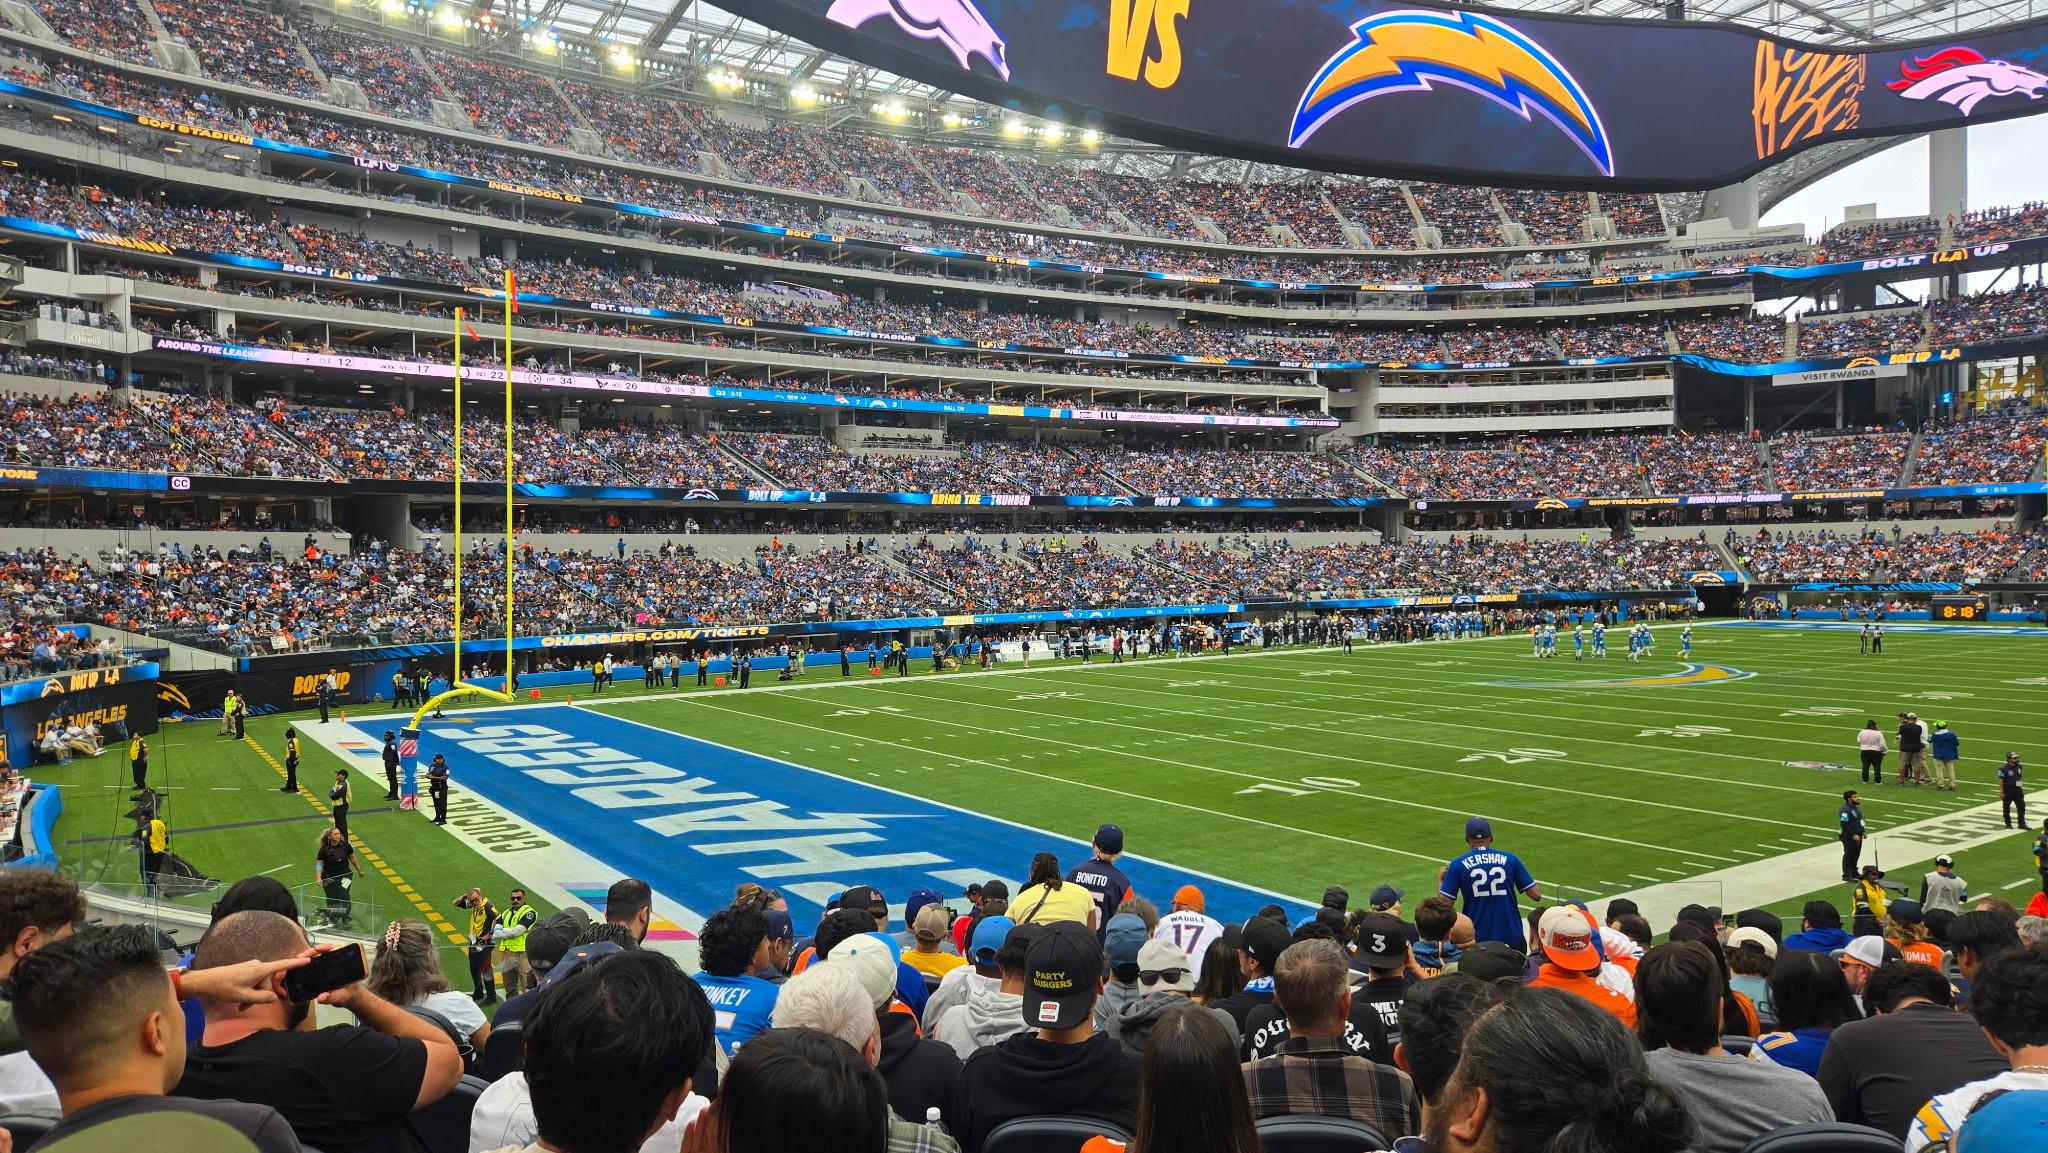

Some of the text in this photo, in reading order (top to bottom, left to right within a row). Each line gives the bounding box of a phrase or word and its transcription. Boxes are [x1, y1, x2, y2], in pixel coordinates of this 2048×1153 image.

[1107, 0, 1189, 89] VS
[138, 115, 253, 145] SOFI STADIUM
[1862, 255, 1926, 271] BOLT
[1974, 244, 2009, 257] UP
[283, 264, 326, 276] BOLT
[355, 273, 378, 281] UP
[590, 302, 617, 312] EST.
[871, 332, 916, 342] STADIUM
[157, 339, 262, 359] AROUND THE LEAGUE
[338, 358, 352, 367] 12
[1890, 348, 1960, 365] BOLT UP LA
[417, 364, 430, 373] 17
[1801, 368, 1876, 381] VISIT RWANDA
[490, 371, 504, 380] 22
[560, 376, 572, 385] 34
[625, 382, 638, 390] 26
[174, 479, 188, 488] CC
[748, 490, 827, 502] BOLT UP LA
[964, 494, 981, 505] THE
[990, 494, 1031, 506] THUNDER
[1154, 497, 1213, 506] BOLT UP LA
[1746, 494, 1782, 502] CHARGERS
[1475, 595, 1518, 603] CHARGERS
[1943, 605, 1974, 618] 8:18
[541, 626, 769, 647] CHARGERS.COM/TICKETS
[70, 673, 87, 692] BOLT
[104, 668, 120, 685] LA
[1640, 724, 1732, 738] 30
[1466, 747, 1568, 764] 20
[1249, 776, 1361, 796] 10
[1462, 853, 1507, 870] KERSHAW
[1076, 871, 1108, 887] BONITTO
[1470, 866, 1507, 898] 22
[1173, 923, 1205, 955] 17
[1371, 933, 1386, 953] 3
[1905, 951, 1933, 963] OMAS
[1035, 970, 1066, 980] PARTY
[1033, 977, 1073, 989] BURGERS
